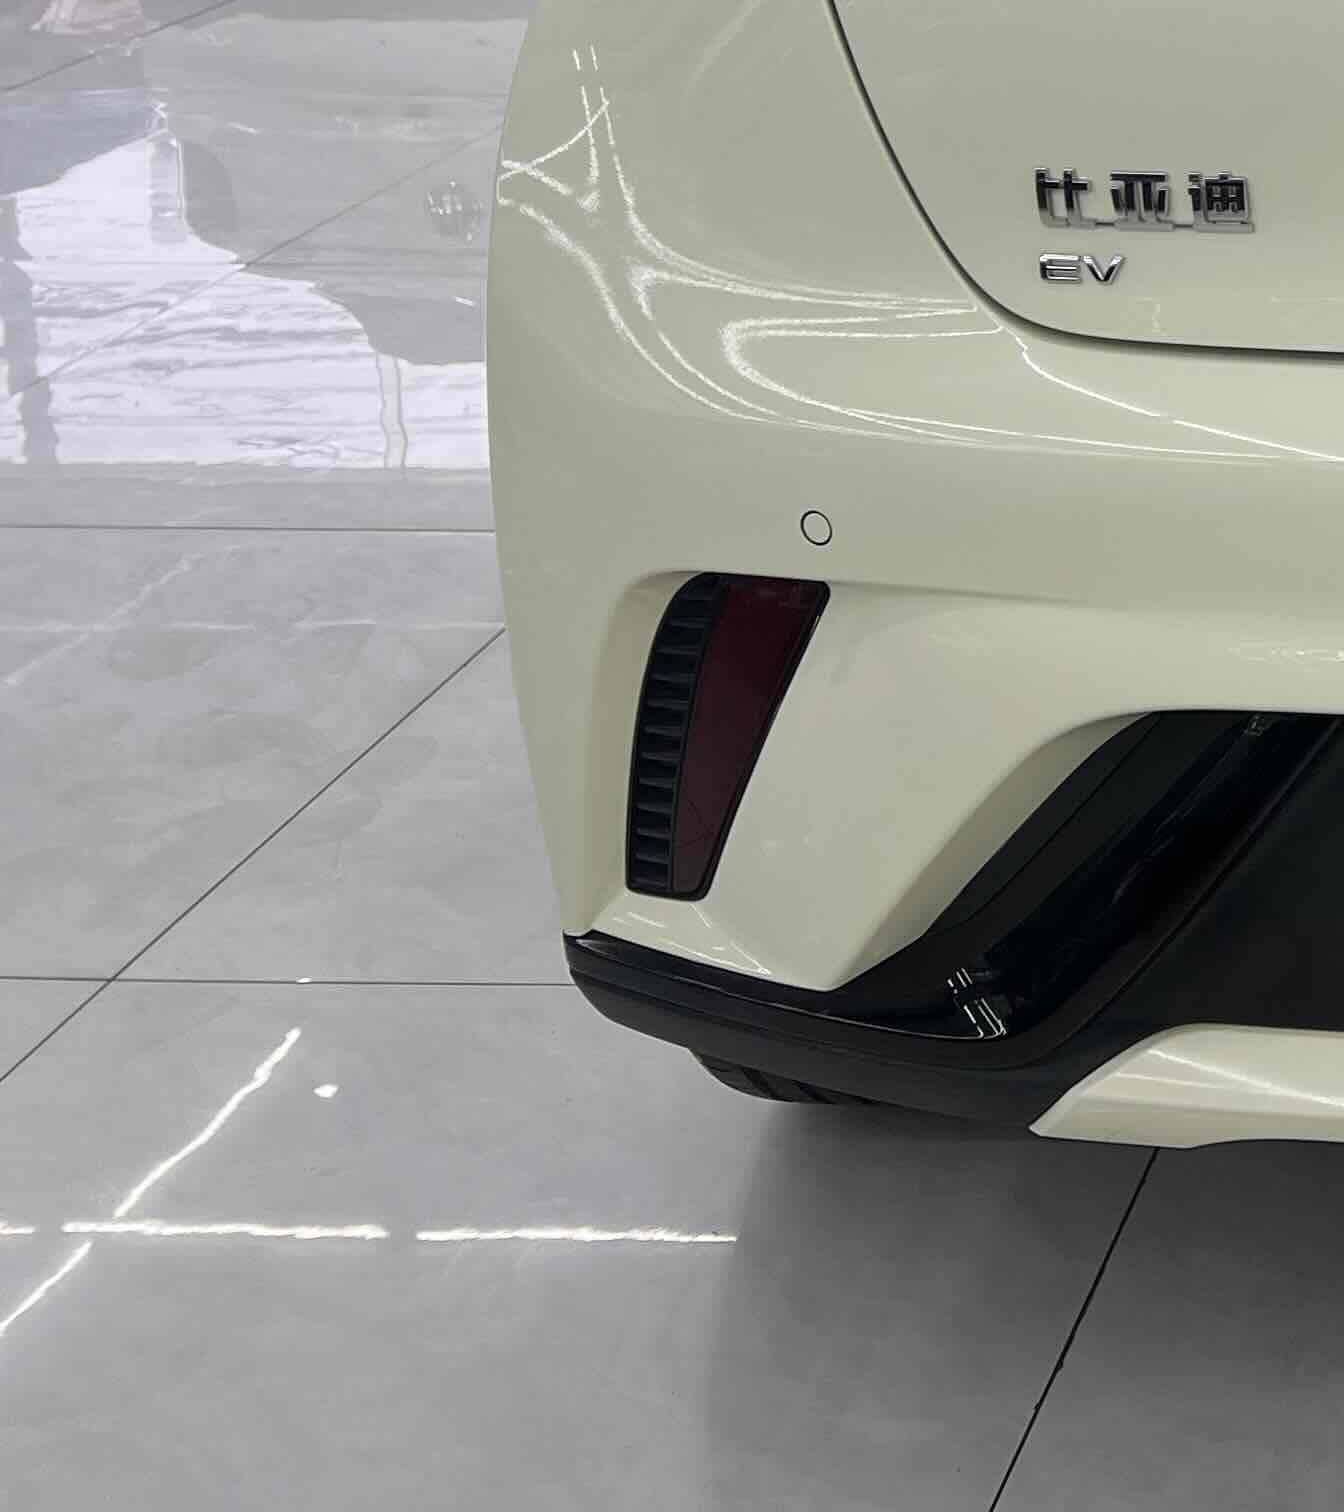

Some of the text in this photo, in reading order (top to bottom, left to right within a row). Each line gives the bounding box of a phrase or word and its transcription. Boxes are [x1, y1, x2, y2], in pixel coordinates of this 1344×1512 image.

[1034, 167, 1254, 233] 比亚迪
[1039, 253, 1124, 285] EV
